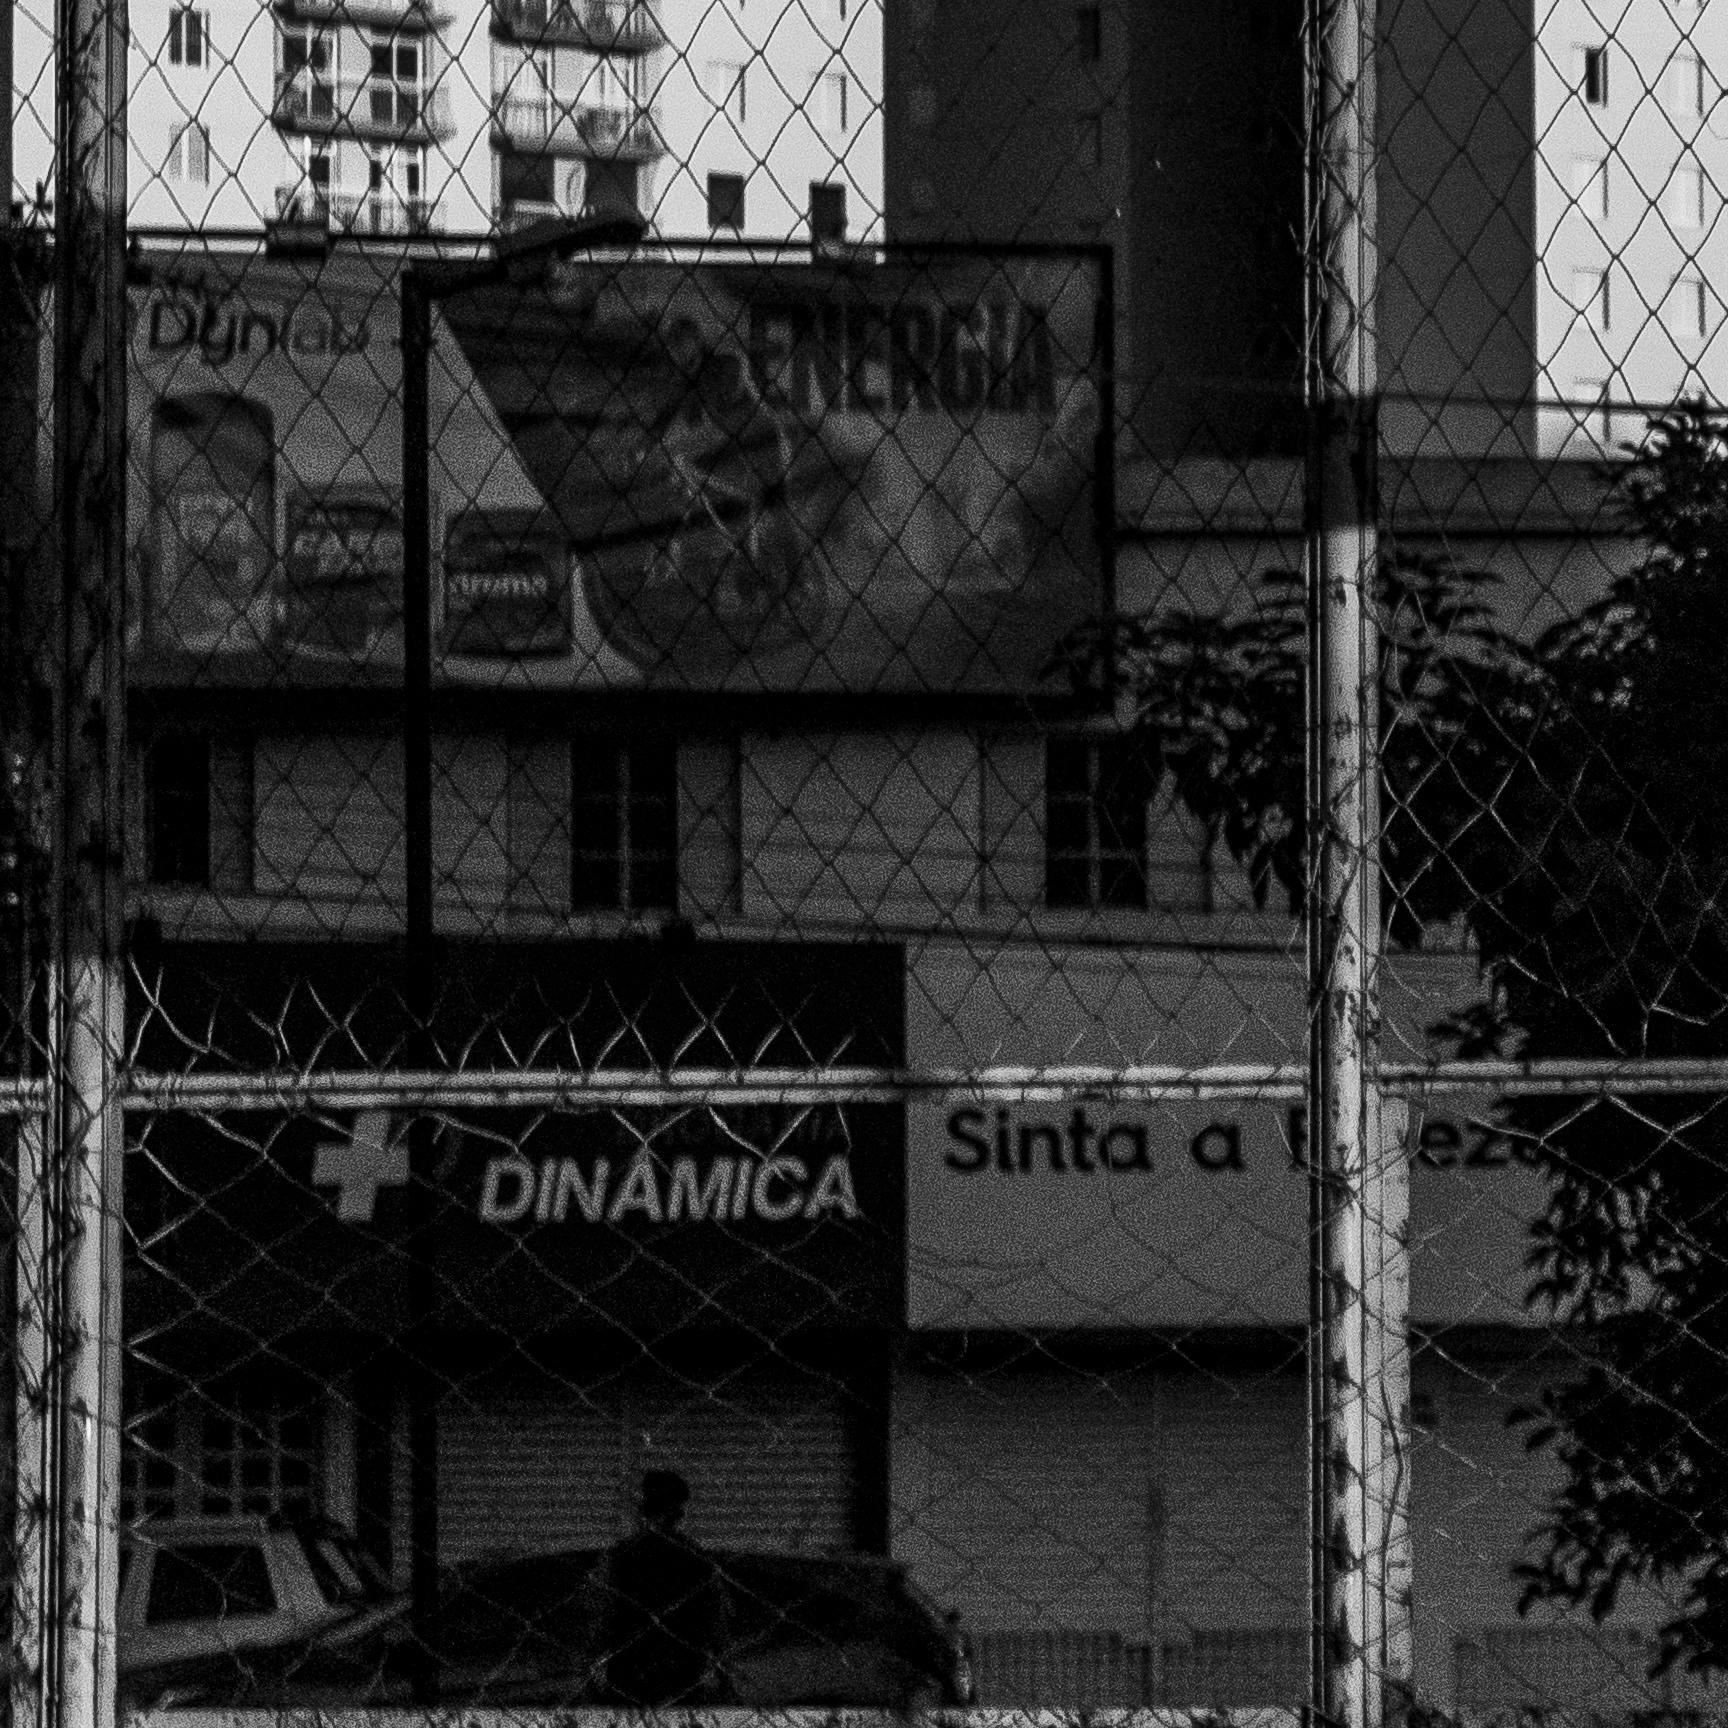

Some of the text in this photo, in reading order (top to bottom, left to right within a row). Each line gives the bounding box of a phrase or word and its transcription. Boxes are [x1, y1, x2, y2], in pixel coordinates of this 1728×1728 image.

[749, 300, 1056, 412] ENERGIA
[944, 1108, 1152, 1173] Sinta
[1191, 1123, 1246, 1173] a
